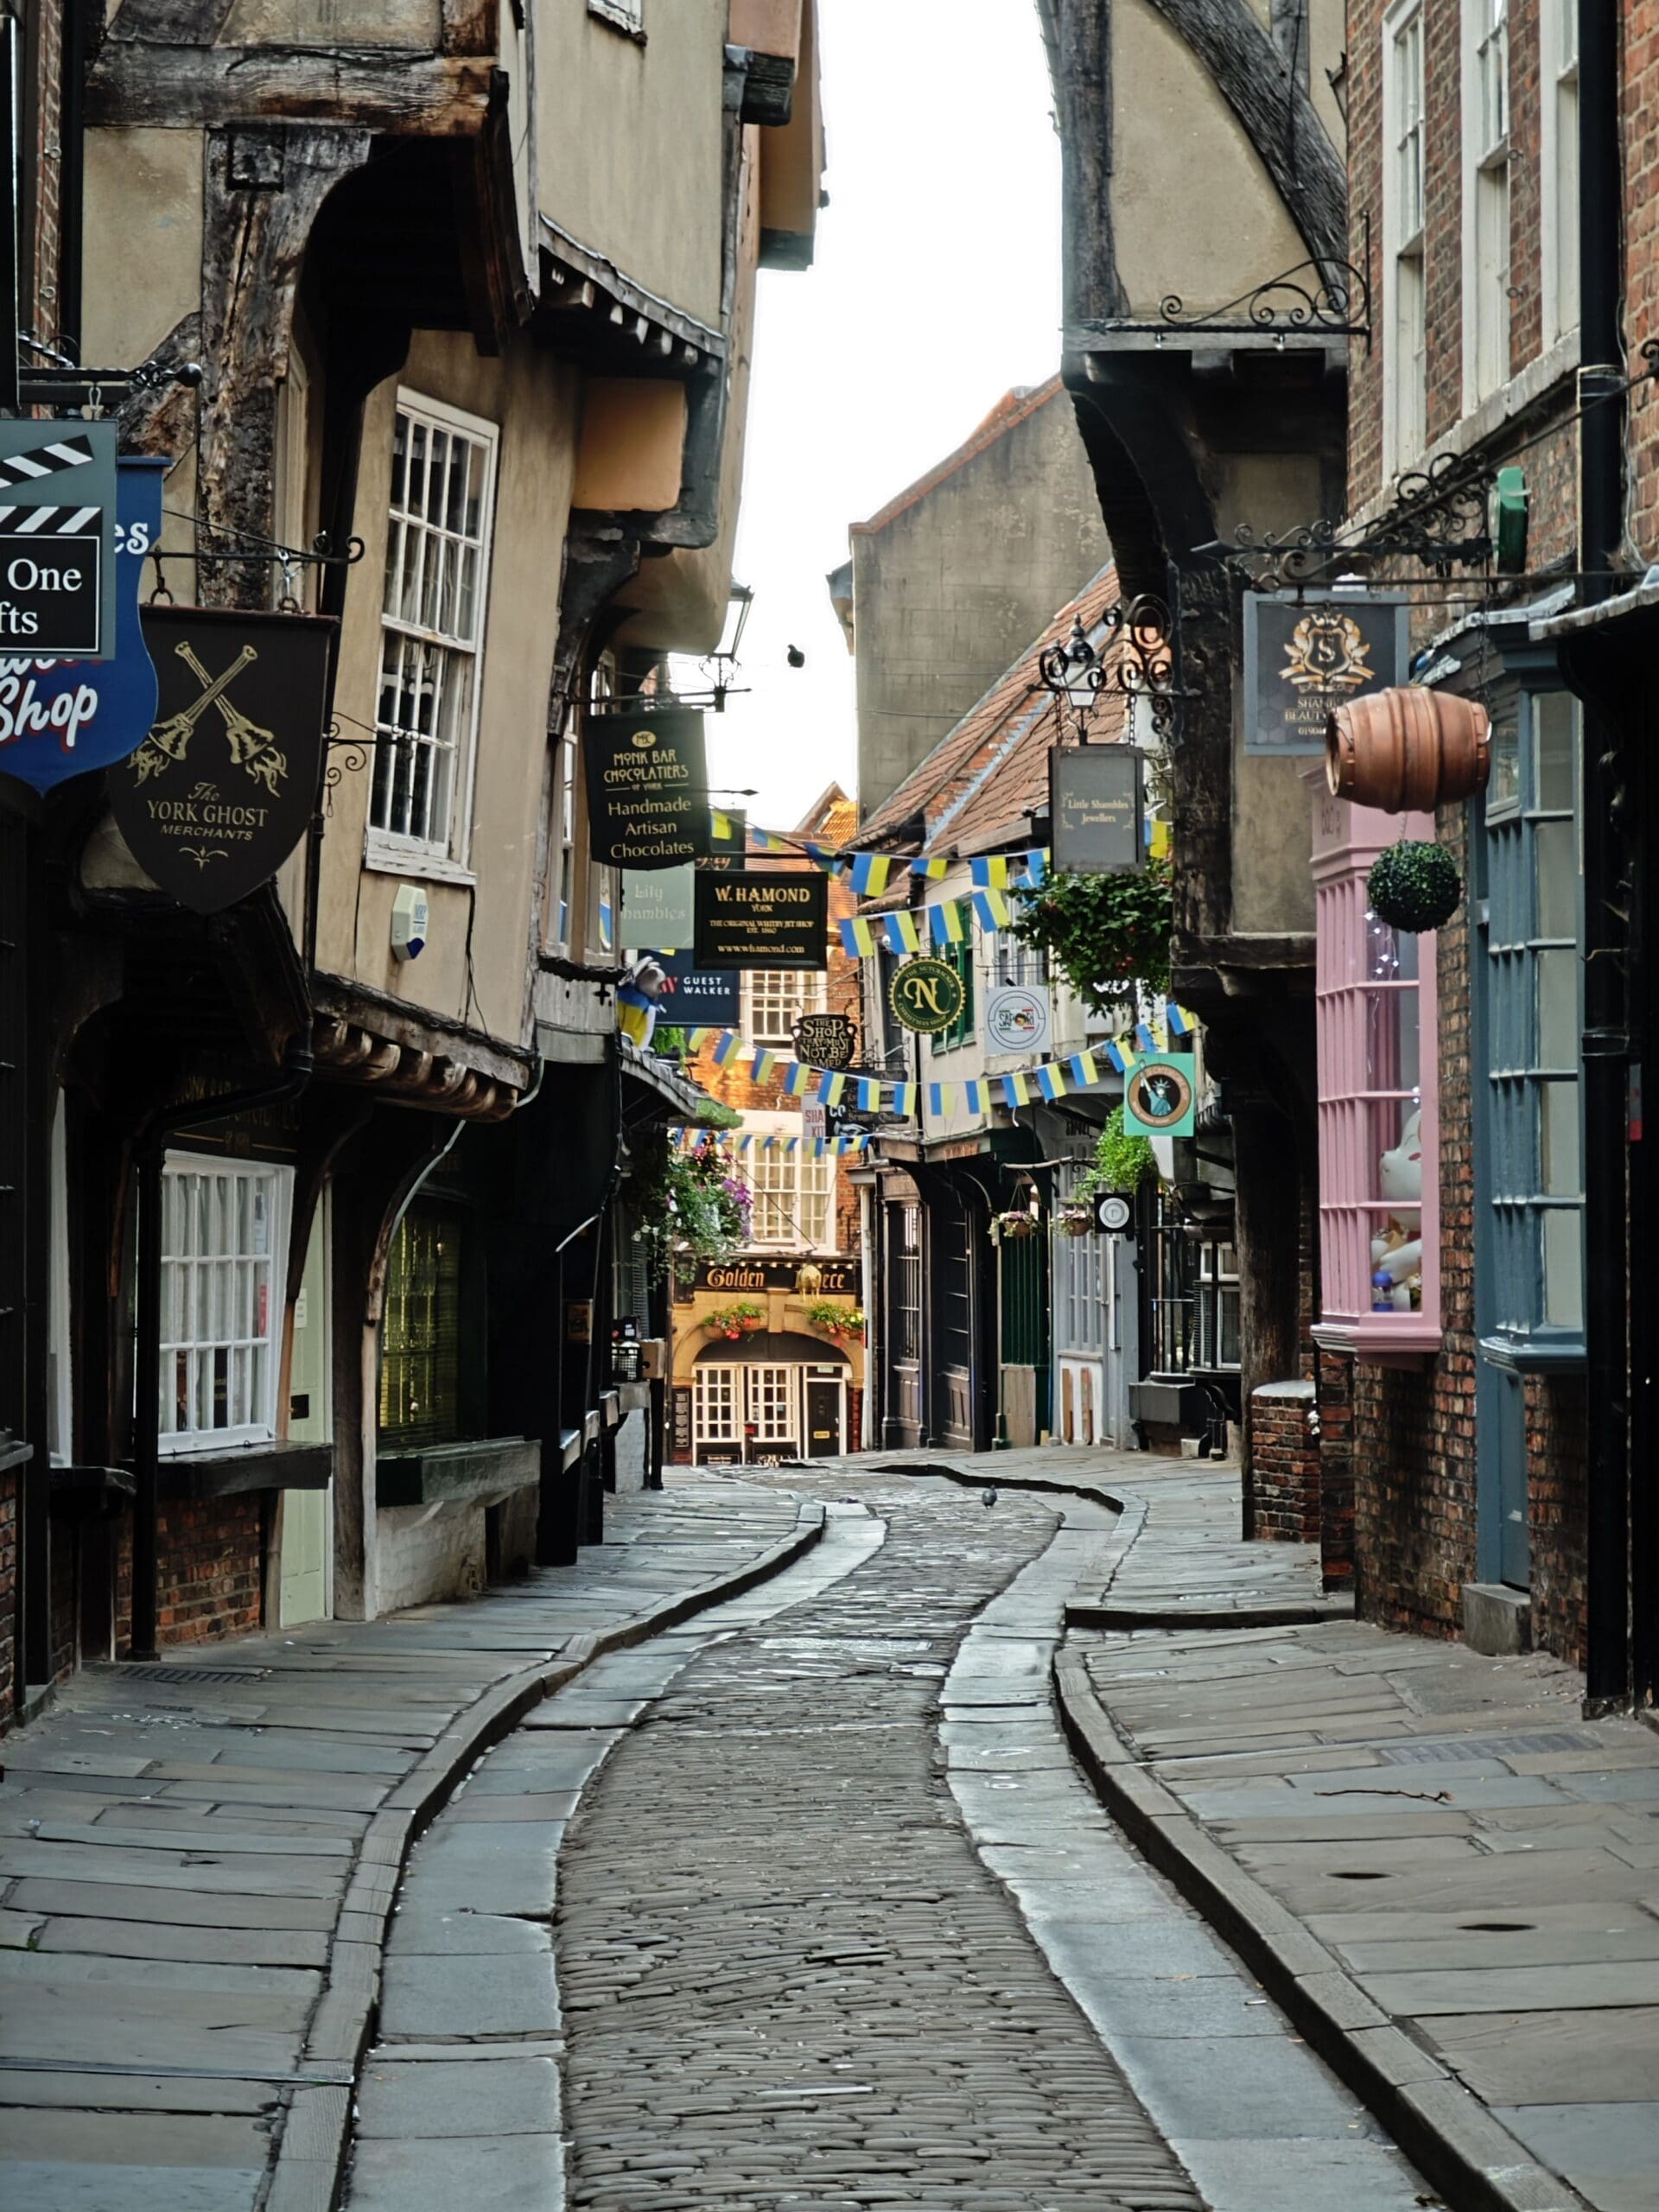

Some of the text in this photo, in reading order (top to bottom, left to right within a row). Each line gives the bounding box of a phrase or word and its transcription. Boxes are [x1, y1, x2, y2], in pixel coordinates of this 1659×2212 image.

[7, 558, 82, 592] One
[0, 676, 98, 747] Shop
[613, 749, 677, 766] MONK BAR
[604, 765, 689, 783] CHOCOLATIERS
[188, 782, 220, 802] The
[607, 797, 691, 816] Handmade
[1068, 799, 1128, 809] Little Shambles
[148, 800, 269, 827] YORK GHOST
[1081, 812, 1116, 825] Jewellers
[161, 824, 253, 841] MERCHANTS
[625, 820, 677, 836] Artisan
[610, 841, 695, 858] Chocolates
[635, 885, 663, 902] Lily
[735, 887, 810, 902] HAMOND
[751, 904, 773, 912] YORK
[683, 987, 731, 995] WALKER
[903, 977, 950, 1014] N
[802, 1019, 844, 1038] SHOP
[814, 1018, 831, 1027] THE
[799, 1045, 848, 1060] NOT BE
[806, 1058, 842, 1069] NAMED
[707, 1268, 765, 1287] Golden
